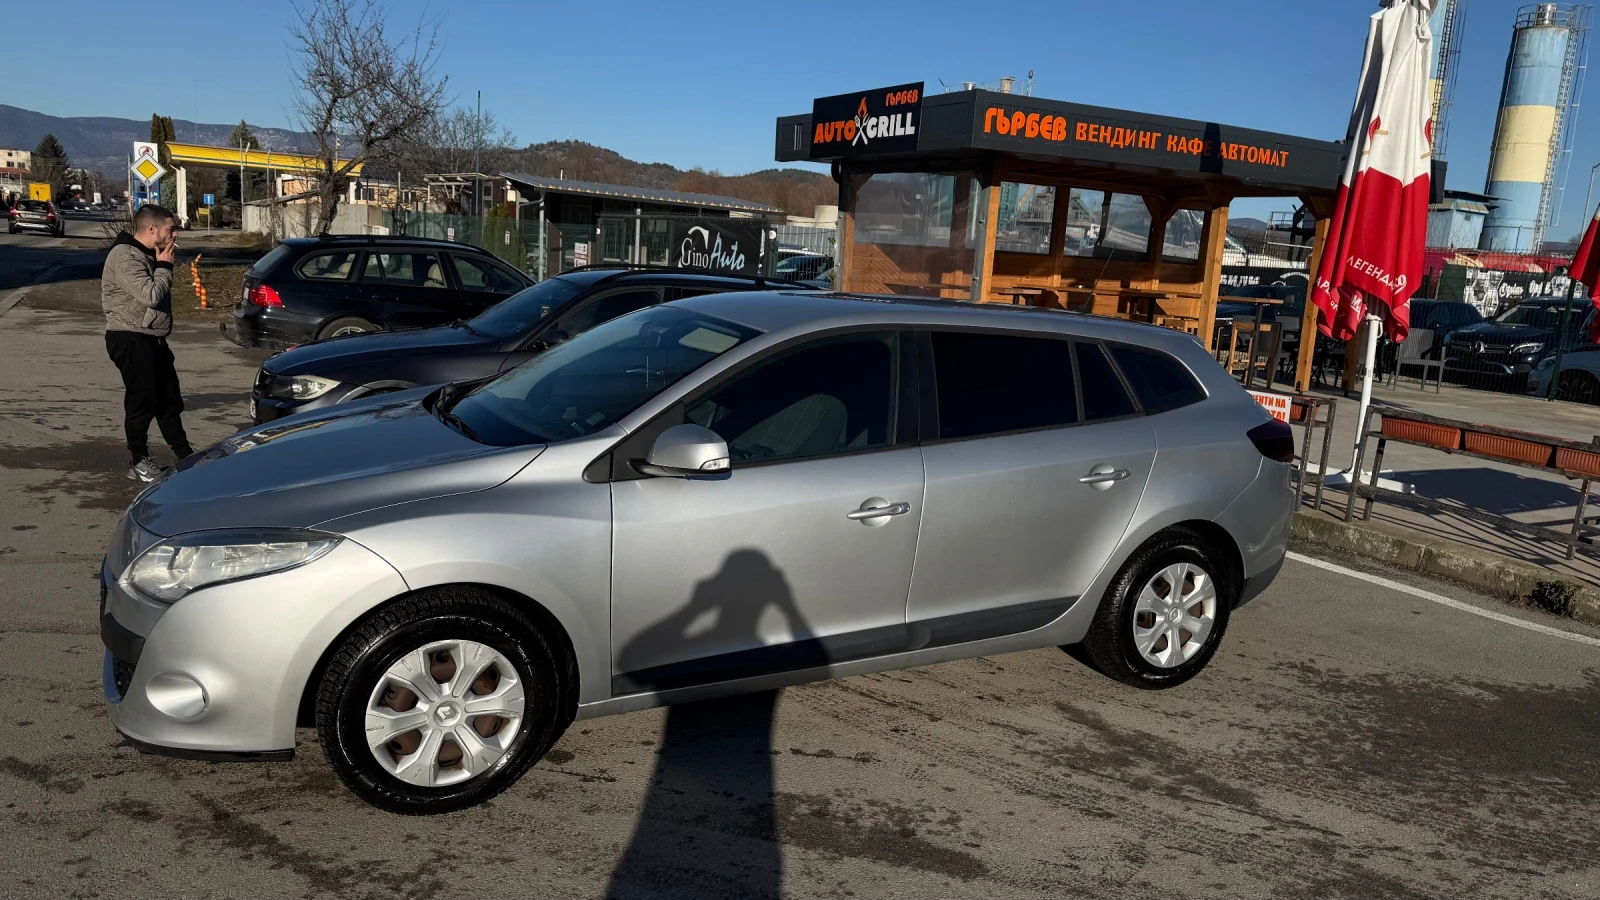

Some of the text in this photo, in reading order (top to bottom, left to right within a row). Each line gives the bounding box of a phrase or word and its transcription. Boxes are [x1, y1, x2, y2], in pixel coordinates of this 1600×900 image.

[885, 89, 919, 107] ГЪРБЕВ
[813, 112, 915, 144] AUTO GRILL
[984, 107, 1290, 168] ГЪРБЕВ ВЕНДИНГ КАФЕ АВТОМАТ
[681, 231, 745, 271] Gino Auto
[1274, 397, 1286, 409] НА
